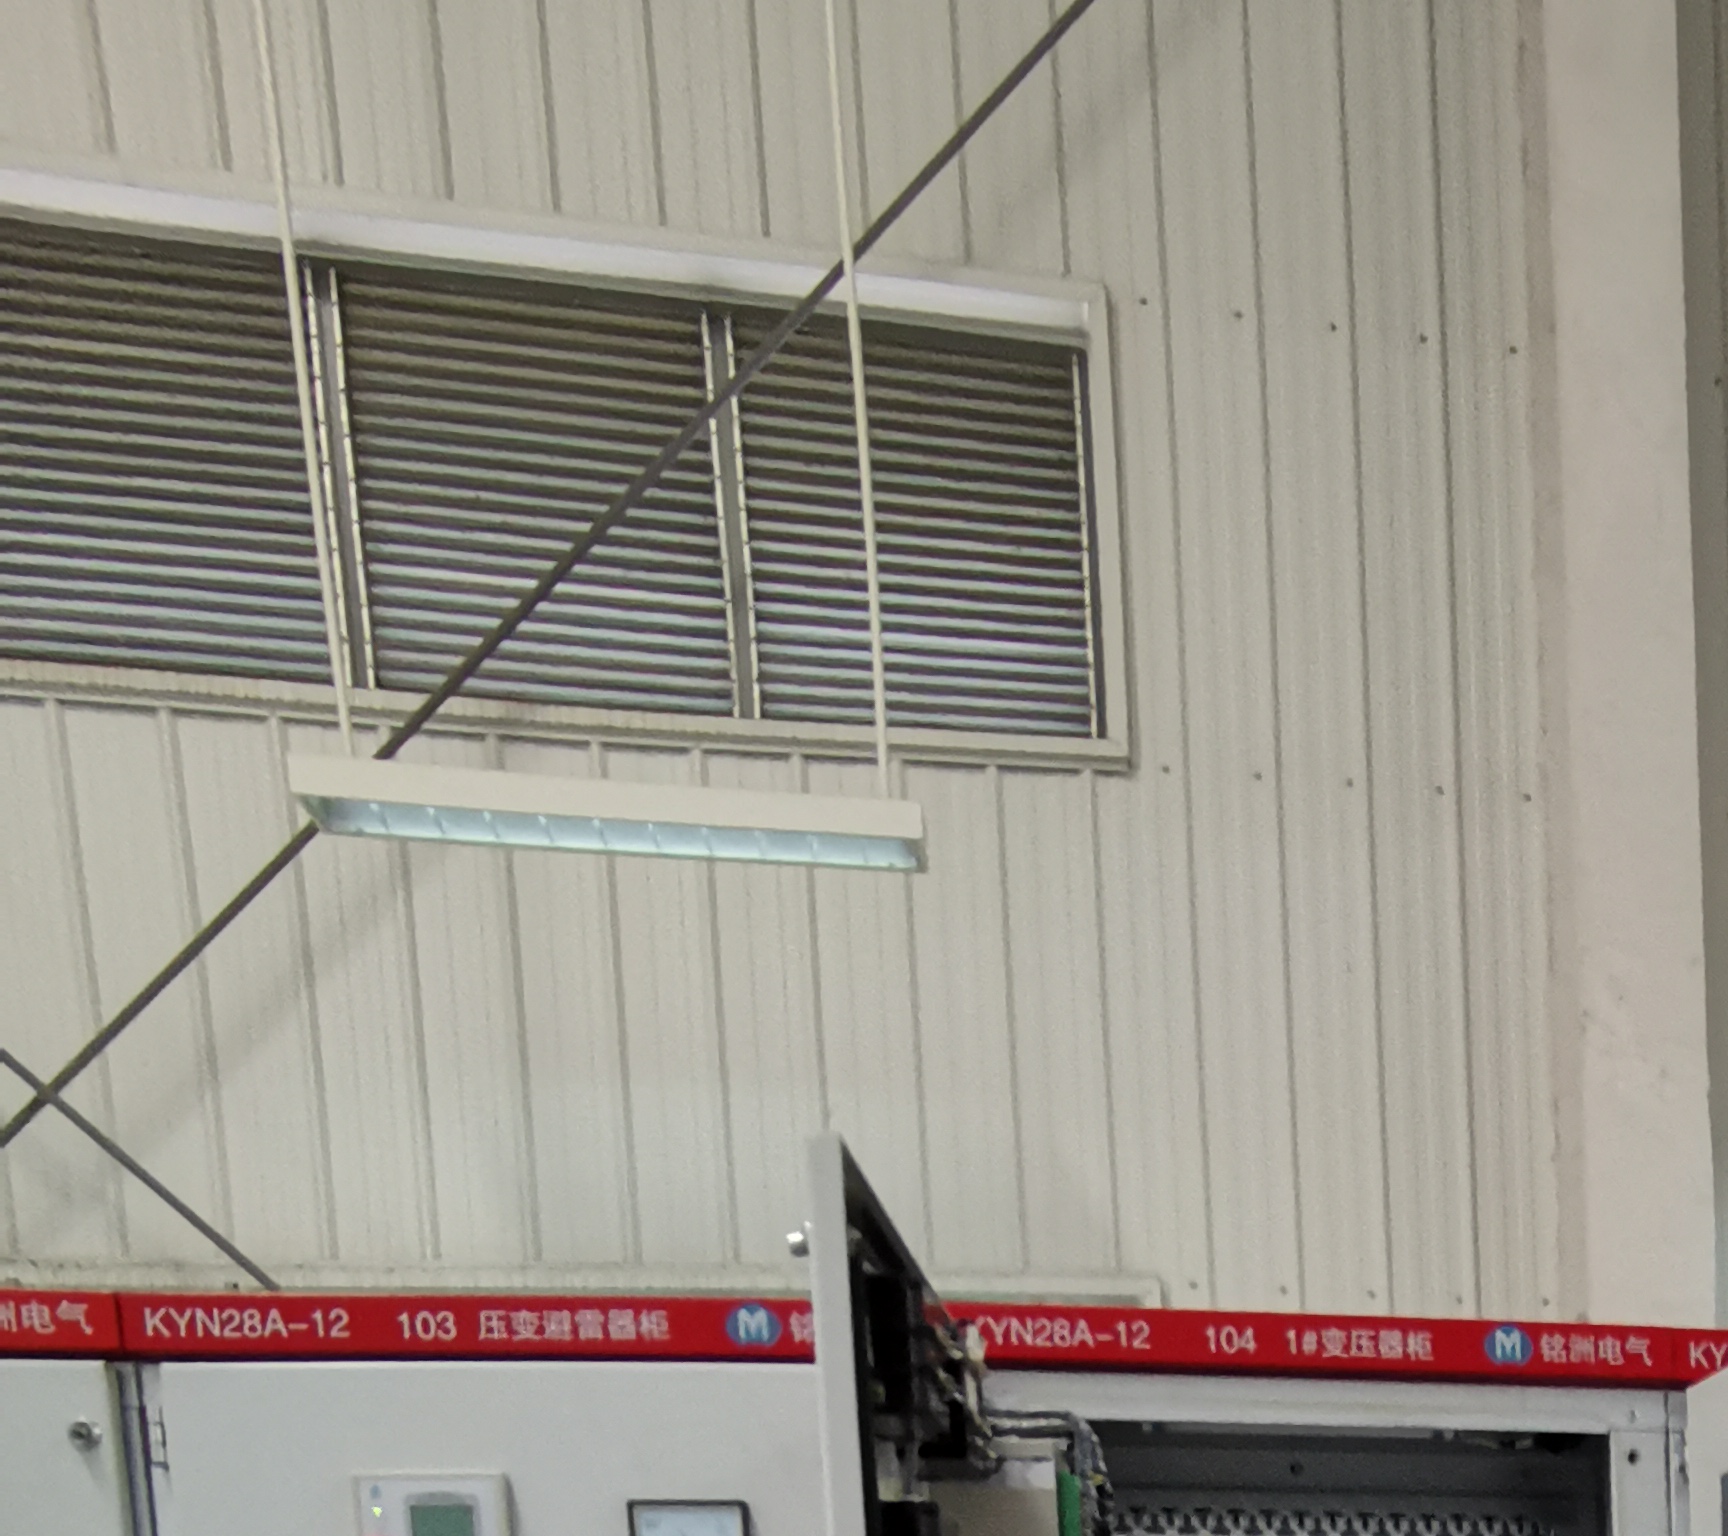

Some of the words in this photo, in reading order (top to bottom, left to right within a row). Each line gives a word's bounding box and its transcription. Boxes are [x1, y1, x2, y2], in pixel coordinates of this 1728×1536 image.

[144, 1307, 351, 1339] KYN28A-12
[397, 1310, 457, 1341] 103
[1206, 1325, 1257, 1355] 104
